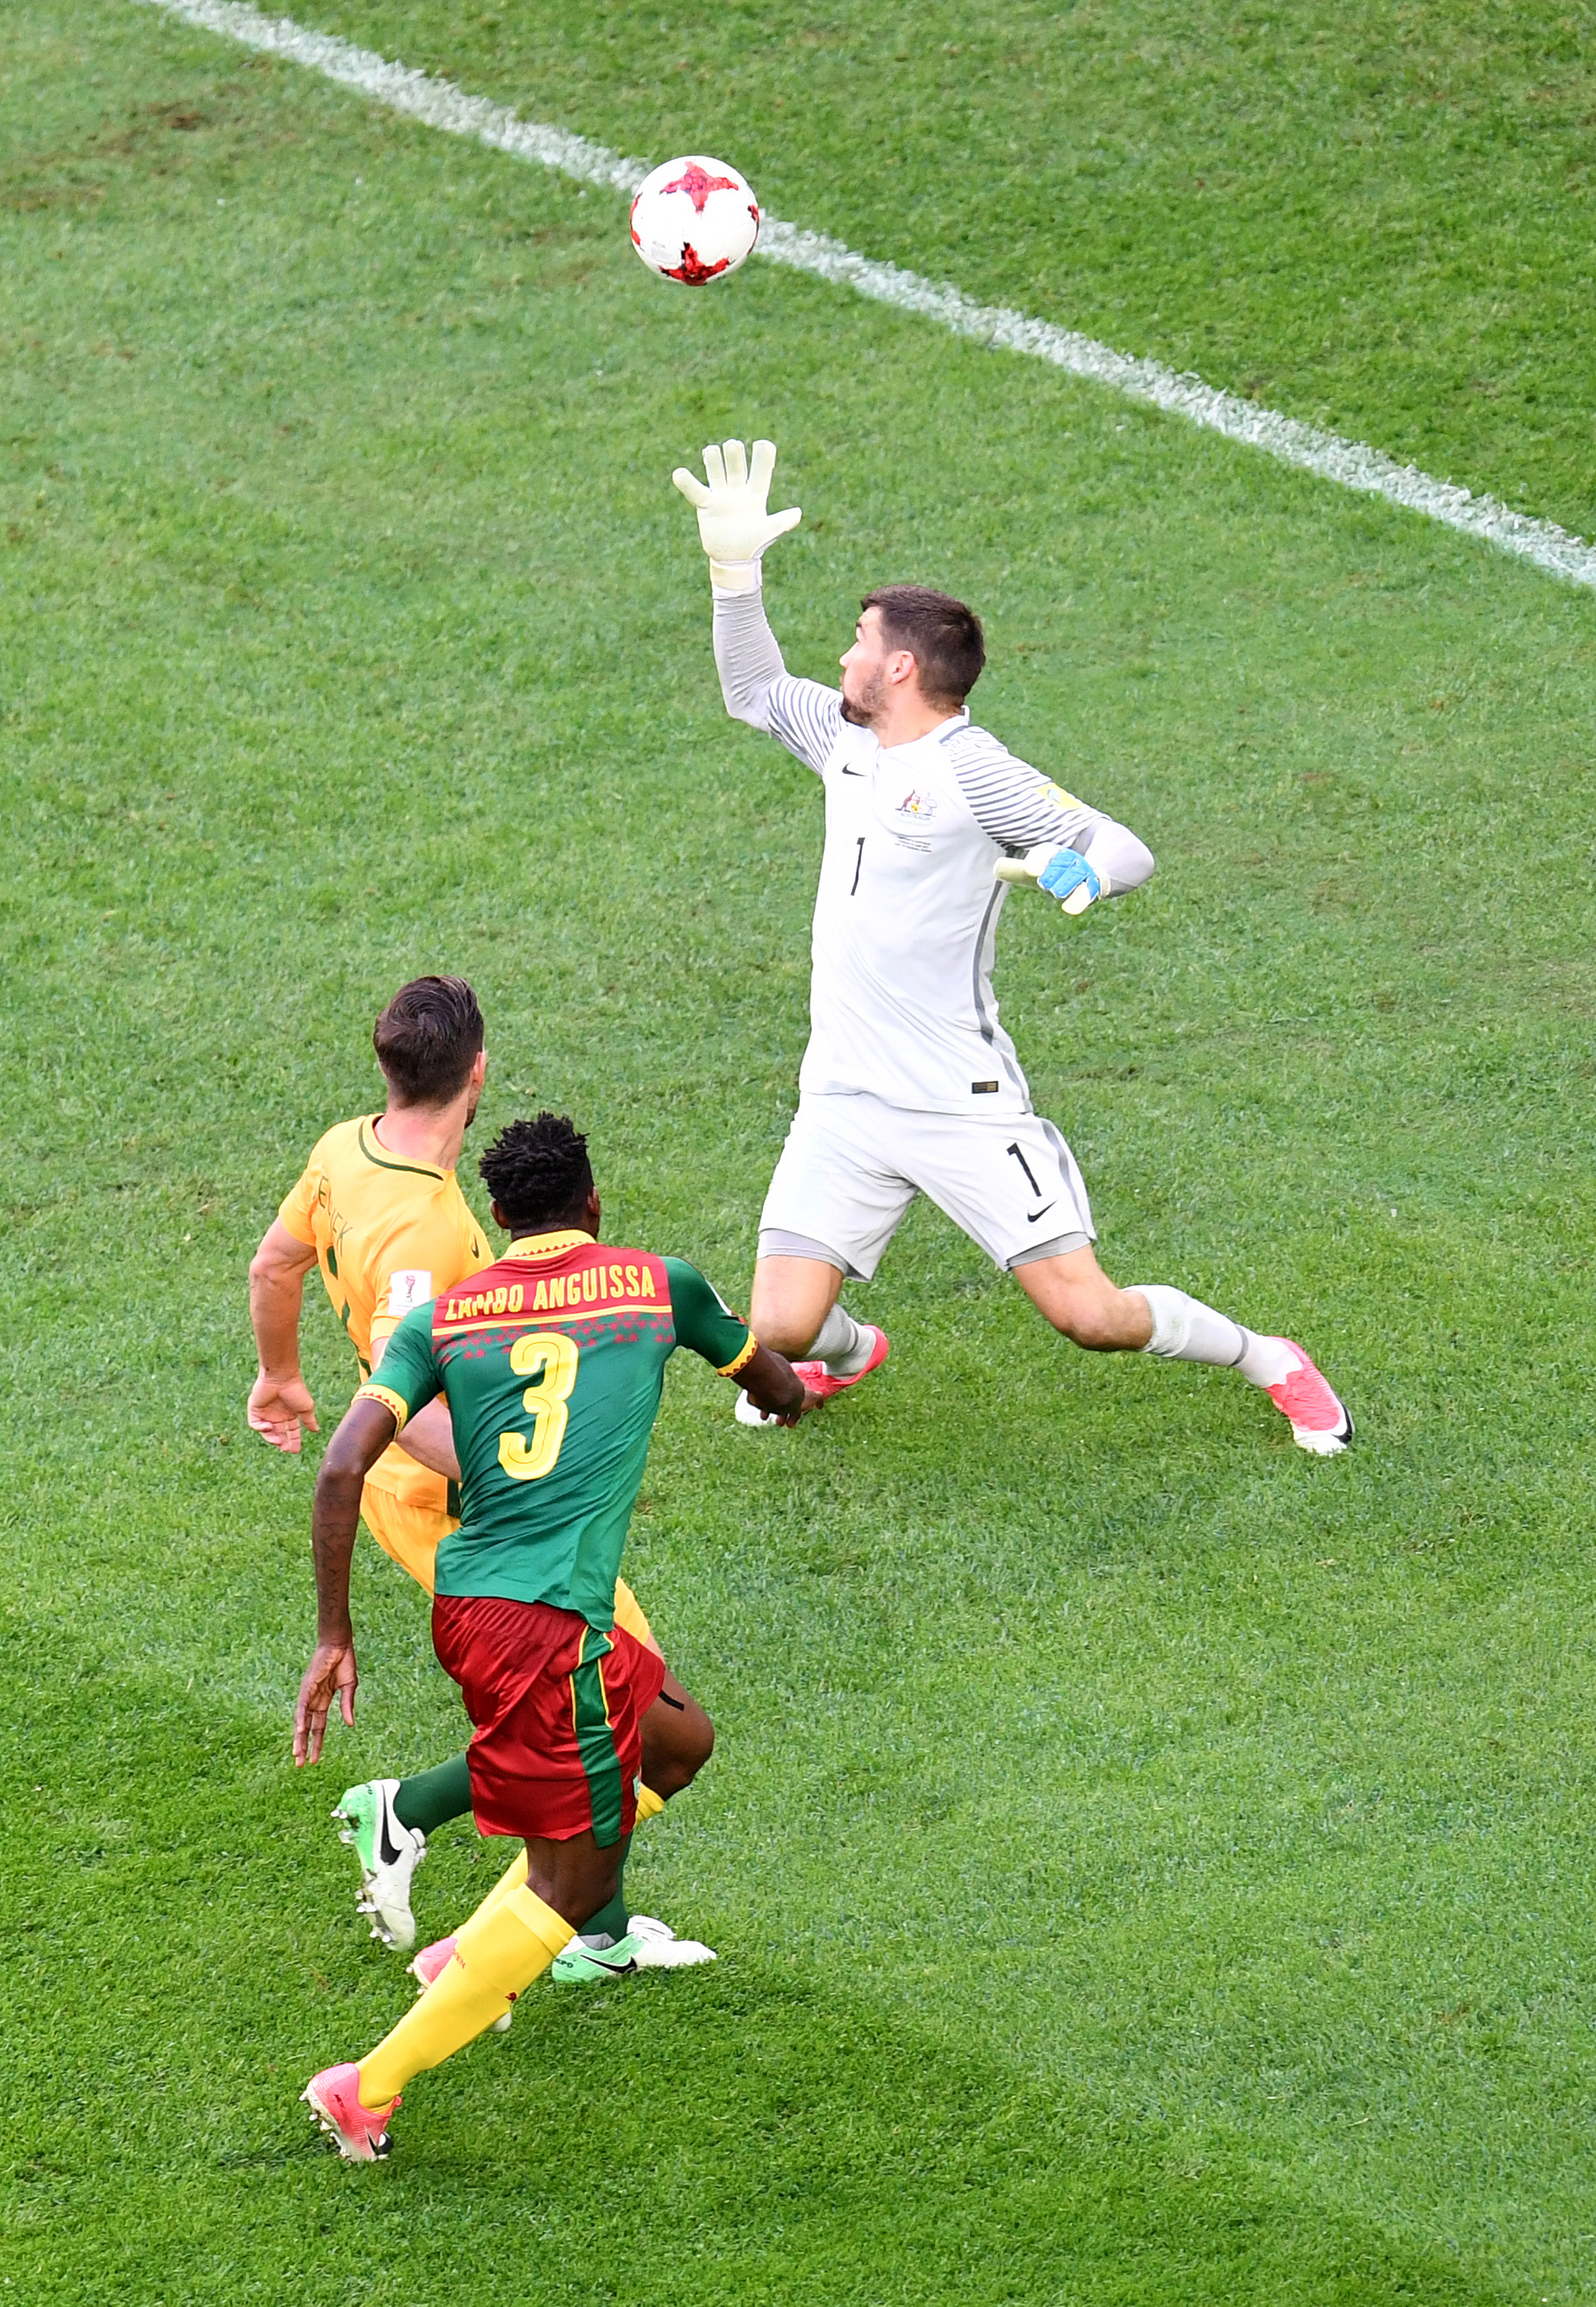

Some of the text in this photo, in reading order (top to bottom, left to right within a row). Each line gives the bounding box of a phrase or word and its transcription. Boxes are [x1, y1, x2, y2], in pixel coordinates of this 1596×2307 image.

[850, 837, 865, 896] 1
[1006, 1142, 1042, 1197] 1
[532, 1264, 656, 1311] ANGUISSA
[498, 1332, 578, 1480] 3
